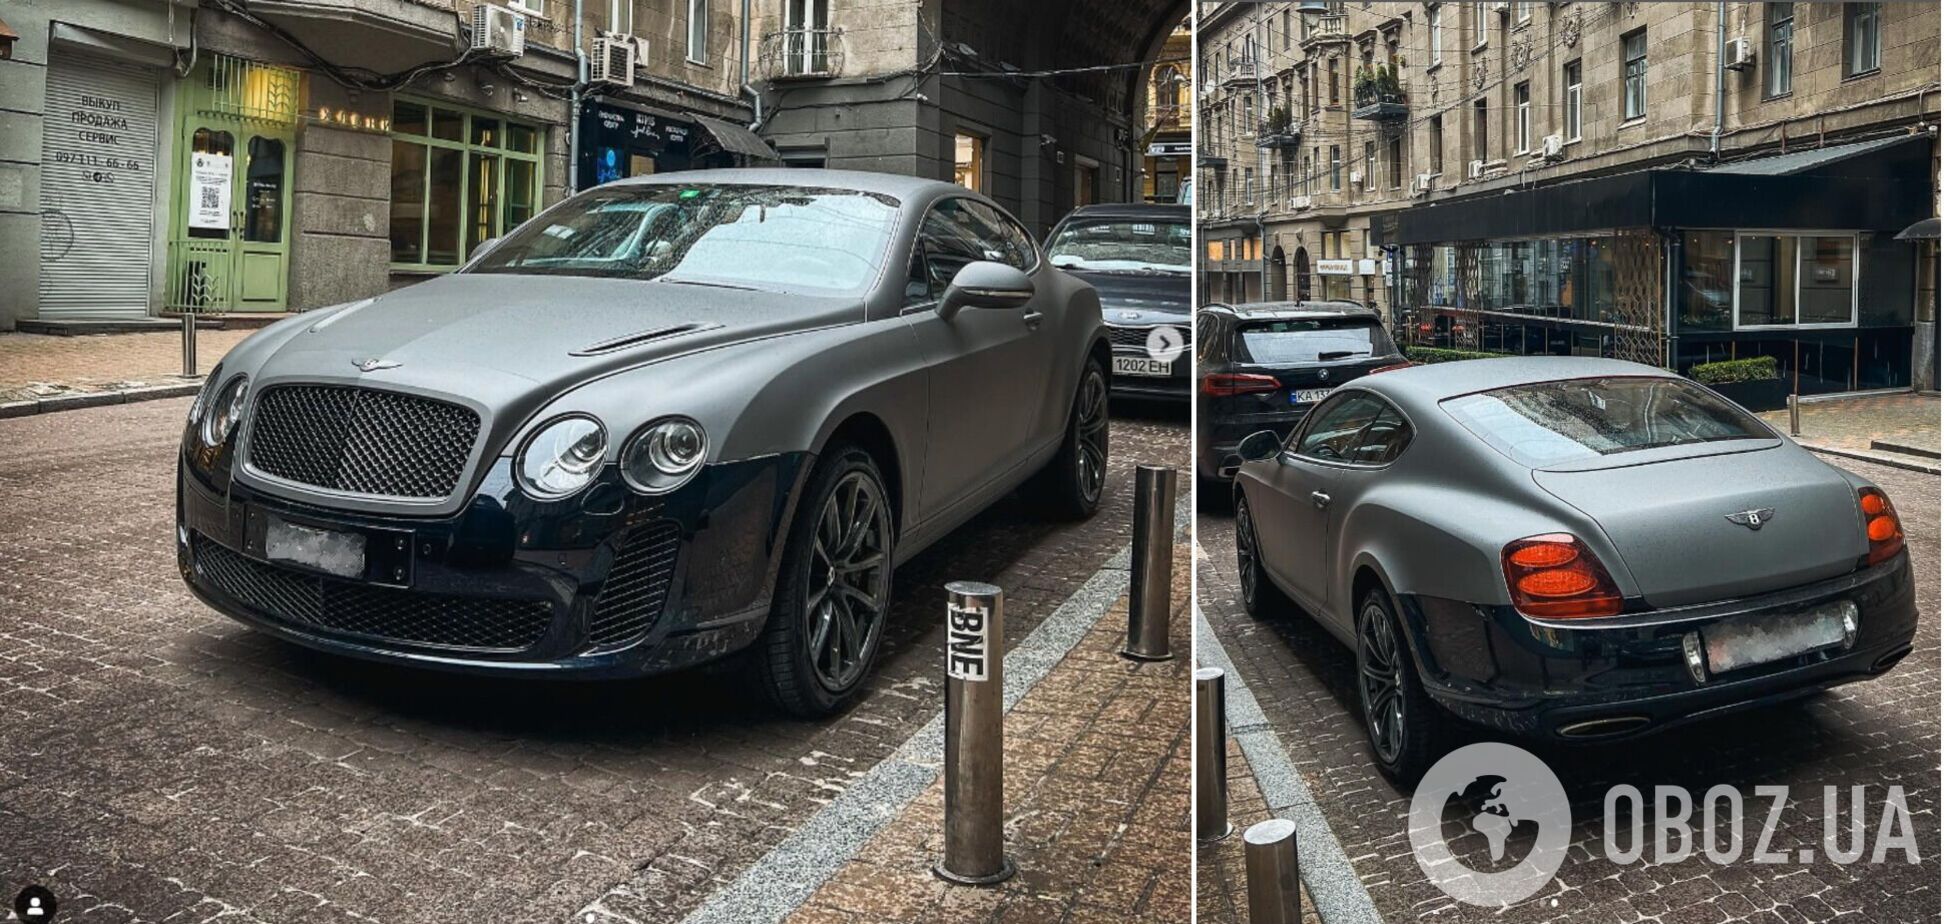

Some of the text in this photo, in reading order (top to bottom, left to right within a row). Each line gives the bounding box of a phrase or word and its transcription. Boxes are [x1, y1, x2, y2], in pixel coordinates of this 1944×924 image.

[81, 96, 120, 111] ВЫКУП
[71, 112, 127, 130] ПРОДАЖА
[79, 131, 120, 145] СЕРВИС
[1116, 358, 1169, 373] 1202 EH
[1297, 391, 1313, 402] KA
[950, 609, 985, 676] BNE
